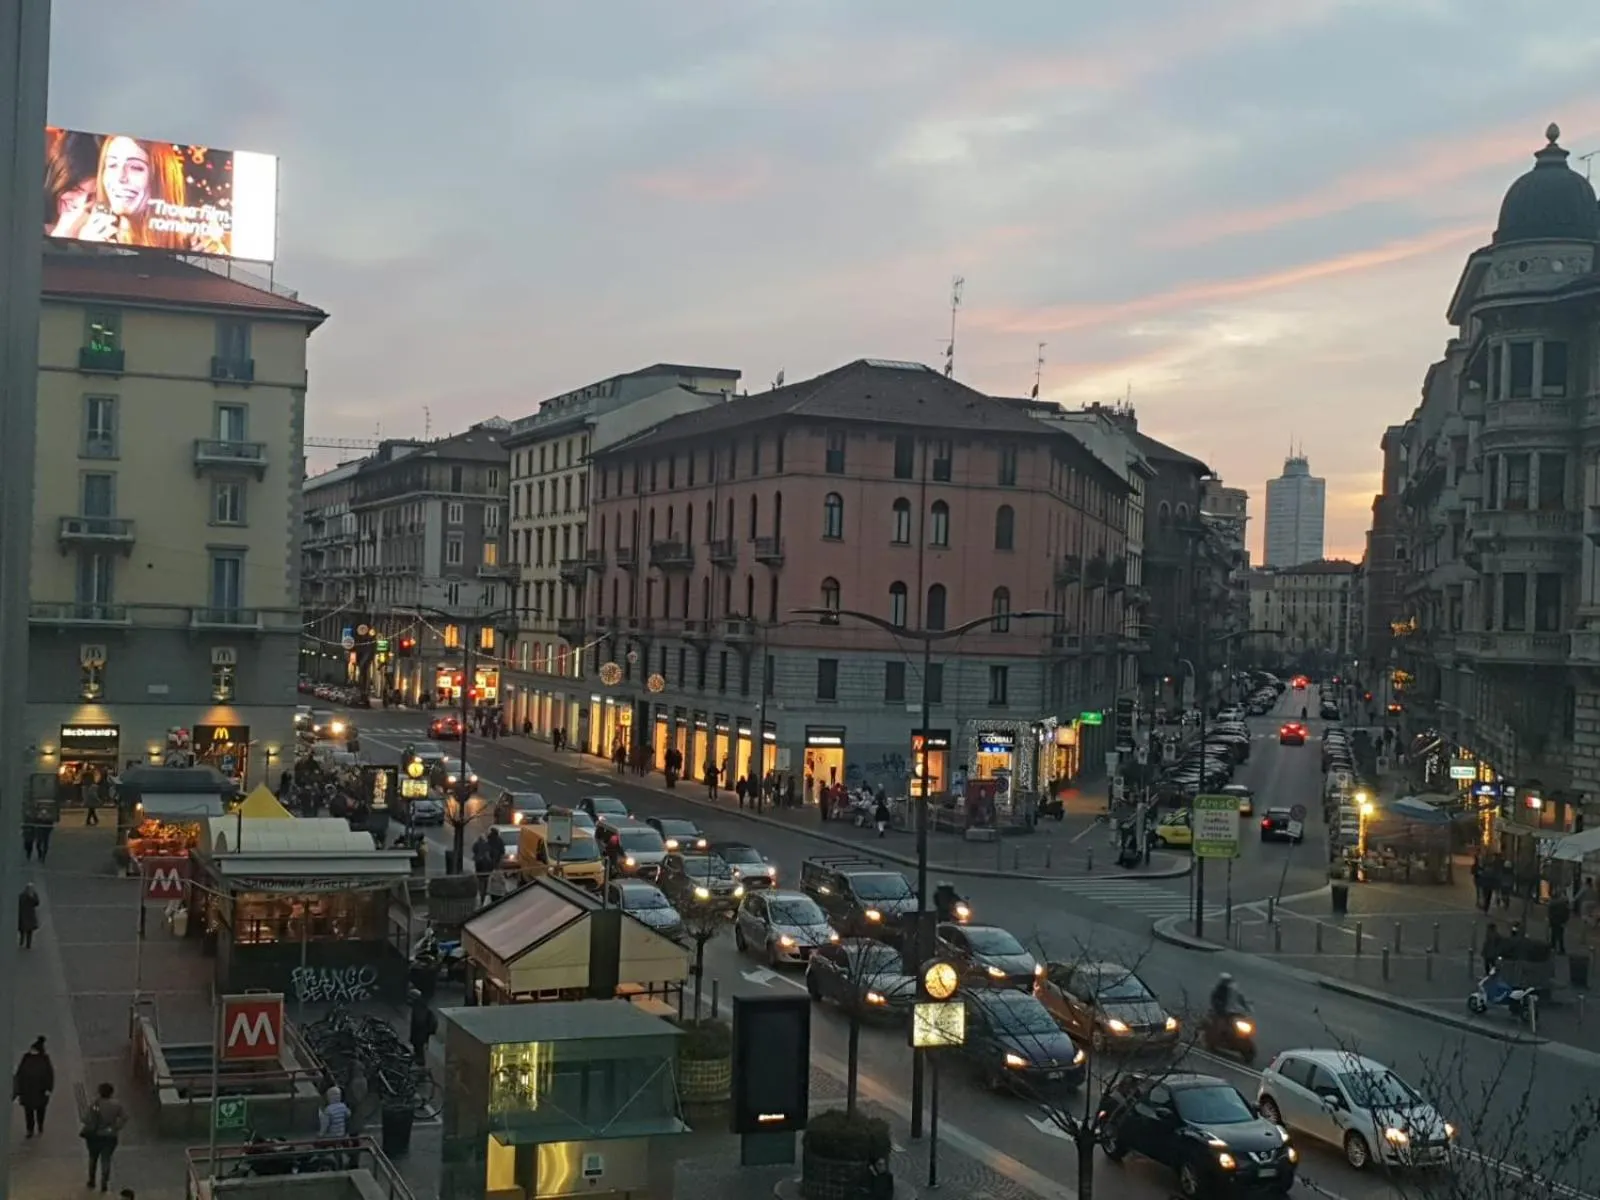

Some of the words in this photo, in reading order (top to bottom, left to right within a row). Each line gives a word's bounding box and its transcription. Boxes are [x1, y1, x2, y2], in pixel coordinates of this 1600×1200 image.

[62, 728, 118, 737] McDonald's
[150, 867, 182, 891] M
[228, 1011, 276, 1047] M
